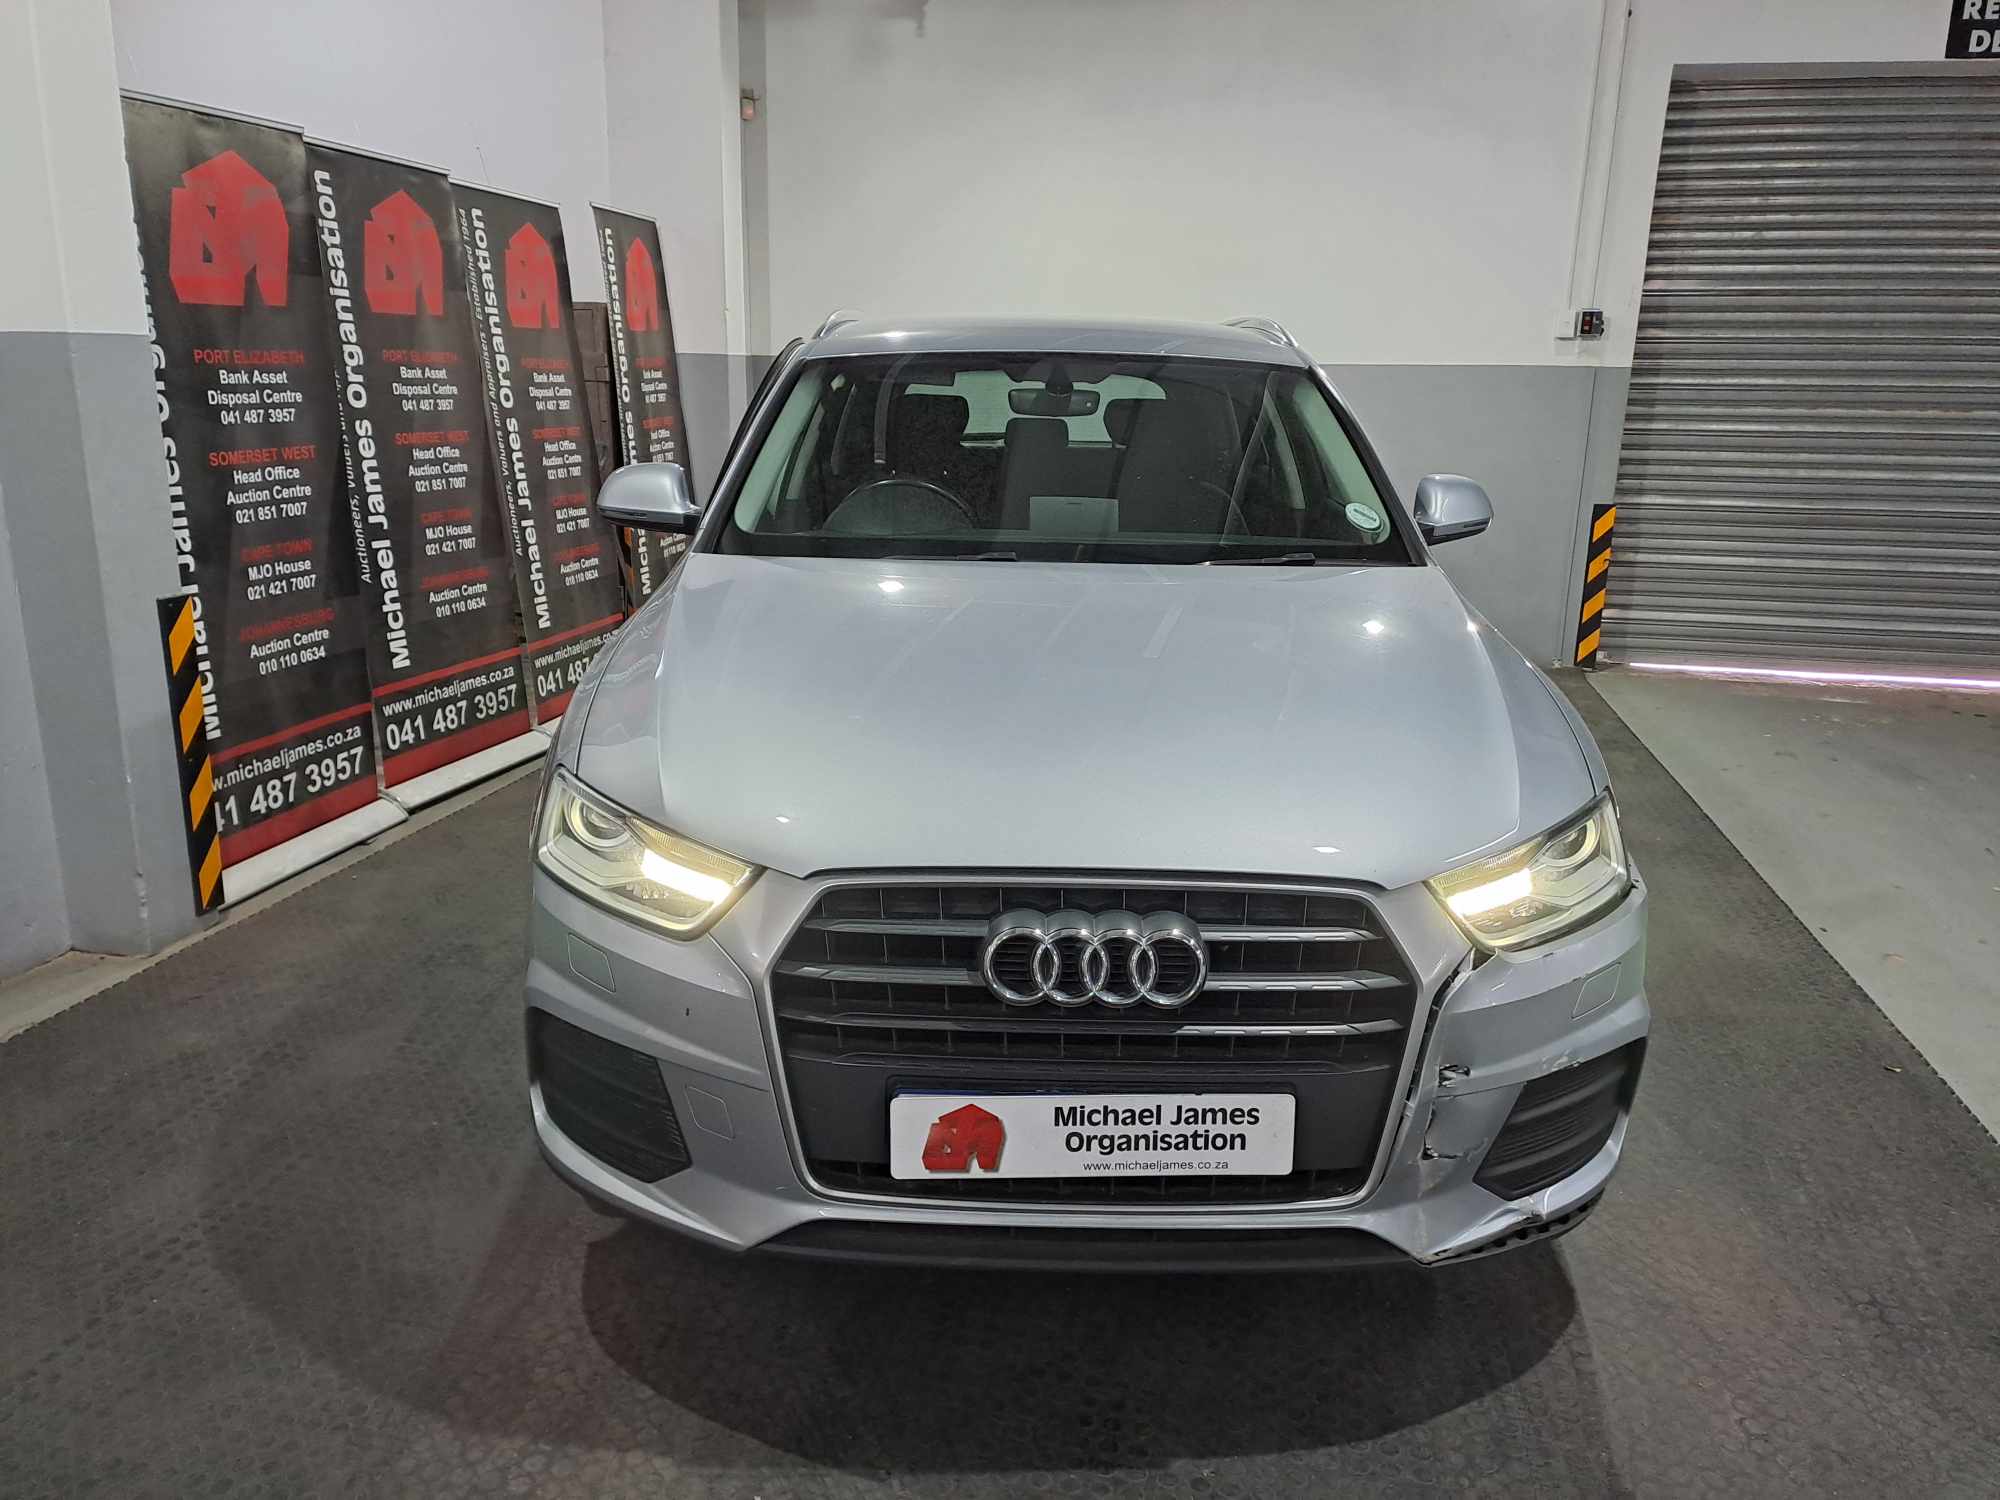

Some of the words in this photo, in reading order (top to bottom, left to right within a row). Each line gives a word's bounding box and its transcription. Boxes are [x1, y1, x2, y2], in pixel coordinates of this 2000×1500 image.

[313, 169, 368, 409] Organisation
[464, 244, 483, 321] Established
[470, 208, 514, 408] Organisation
[604, 228, 630, 403] Organisation
[193, 349, 231, 364] PORT
[219, 370, 250, 385] Bank
[252, 370, 288, 384] Asset
[400, 366, 423, 379] Bank
[424, 367, 448, 379] Asset
[207, 390, 260, 407] Disposal
[263, 389, 303, 404] Centre
[392, 383, 430, 397] Disposal
[432, 382, 458, 395] Centre
[220, 410, 241, 425] 041
[244, 409, 264, 424] 487
[268, 408, 296, 422] 3957
[402, 400, 417, 412] 041
[420, 400, 434, 411] 487
[436, 400, 454, 410] 3957
[490, 401, 502, 428] and
[208, 447, 278, 466] SOMERSET
[281, 445, 316, 460] WEST
[412, 448, 434, 460] Head
[436, 446, 460, 458] Office
[496, 430, 510, 477] Valuers
[506, 417, 532, 512] James
[233, 469, 262, 485] Head
[264, 466, 300, 481] Office
[354, 418, 388, 530] James
[408, 464, 440, 477] Auction
[442, 462, 468, 474] Centre
[226, 489, 270, 506] Auction
[272, 484, 312, 500] Centre
[415, 480, 430, 492] 021
[432, 478, 446, 491] 851
[448, 476, 466, 488] 7007
[235, 509, 255, 524] 021
[257, 505, 278, 521] 851
[280, 502, 308, 518] 7007
[506, 480, 523, 557] Auctioneers,
[350, 494, 372, 584] Auctioneers,
[426, 526, 444, 540] MJO
[446, 524, 472, 537] House
[425, 544, 440, 556] 021
[442, 540, 456, 554] 421
[458, 537, 476, 550] 7007
[248, 564, 272, 581] MJO
[274, 560, 312, 576] House
[520, 518, 551, 630] Michael
[247, 586, 266, 601] 021
[268, 580, 288, 596] 421
[290, 574, 316, 592] 7007
[429, 588, 460, 604] Auction
[462, 582, 488, 597] Centre
[370, 539, 412, 670] Michael
[436, 604, 450, 618] 010
[451, 600, 466, 614] 110
[467, 596, 486, 610] 0634
[250, 638, 291, 659] Auction
[293, 628, 330, 646] Centre
[534, 629, 619, 669] www.michaeljames.co
[260, 658, 279, 676] 010
[280, 652, 298, 668] 110
[300, 645, 326, 664] 0634
[382, 666, 515, 717] www.michaeljames.co.za
[537, 668, 564, 697] 041
[386, 714, 425, 751] 041
[432, 700, 468, 733] 487
[474, 684, 517, 720] 3957
[213, 725, 362, 792] w.michaeljames.co.za
[250, 772, 298, 815] 487
[304, 745, 364, 793] 3957
[1054, 1104, 1162, 1126] Michael
[1170, 1105, 1260, 1126] James
[1065, 1129, 1246, 1155] Organisation
[1083, 1160, 1229, 1173] www.michaeljames.co.za
